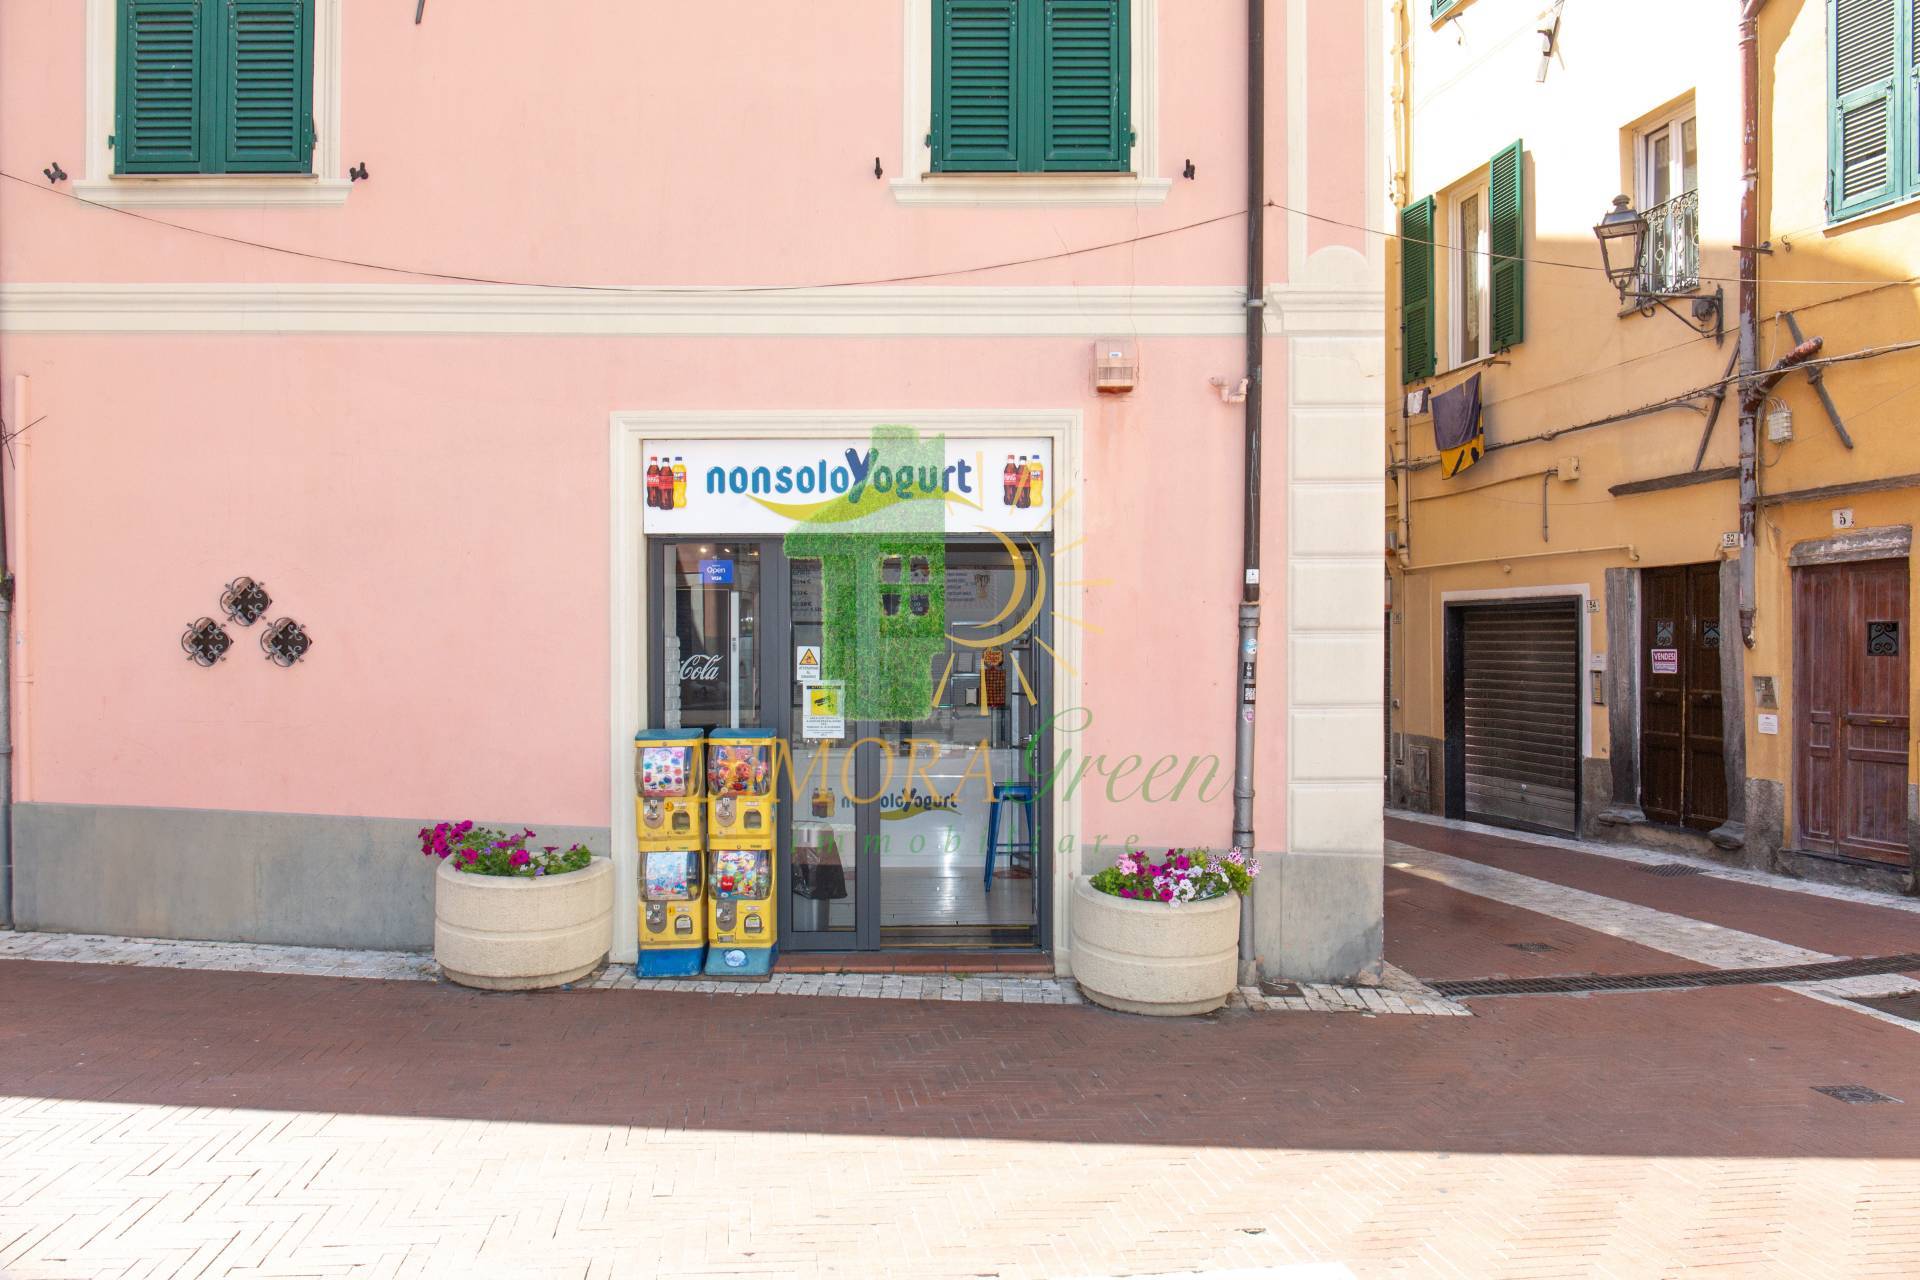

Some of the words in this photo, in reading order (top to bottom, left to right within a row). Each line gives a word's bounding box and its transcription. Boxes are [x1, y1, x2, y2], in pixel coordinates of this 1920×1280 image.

[706, 447, 972, 503] nonsoloYogurt
[1726, 534, 1735, 543] 52
[706, 566, 726, 575] Open
[1653, 652, 1676, 661] VENDESI
